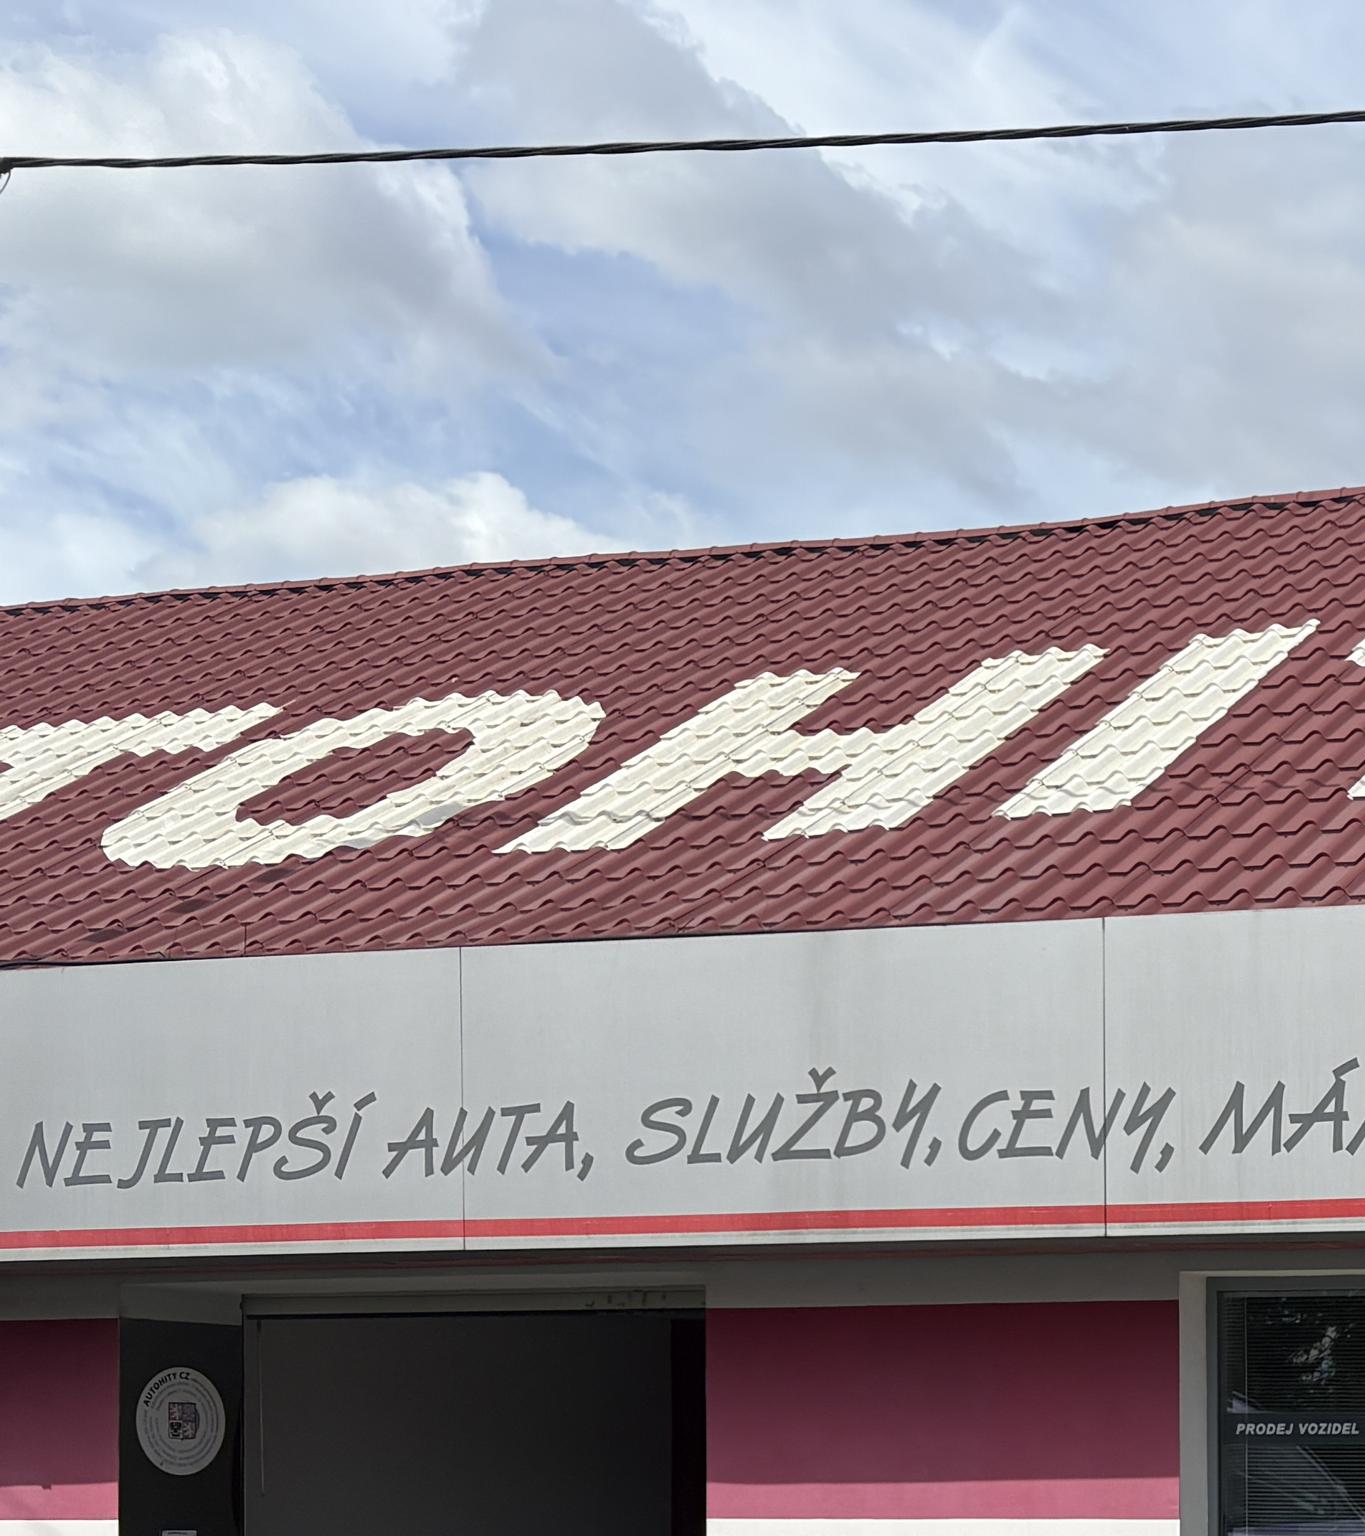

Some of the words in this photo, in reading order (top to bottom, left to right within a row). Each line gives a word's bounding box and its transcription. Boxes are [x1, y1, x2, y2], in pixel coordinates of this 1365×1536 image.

[16, 1091, 376, 1190] NEJLEPŠÍ
[382, 1101, 593, 1181] AUTA,
[143, 1373, 177, 1407] AUTOHITY
[179, 1371, 191, 1381] CZ
[1236, 1423, 1294, 1435] PRODEJ
[1299, 1423, 1360, 1435] VOZIDEL
